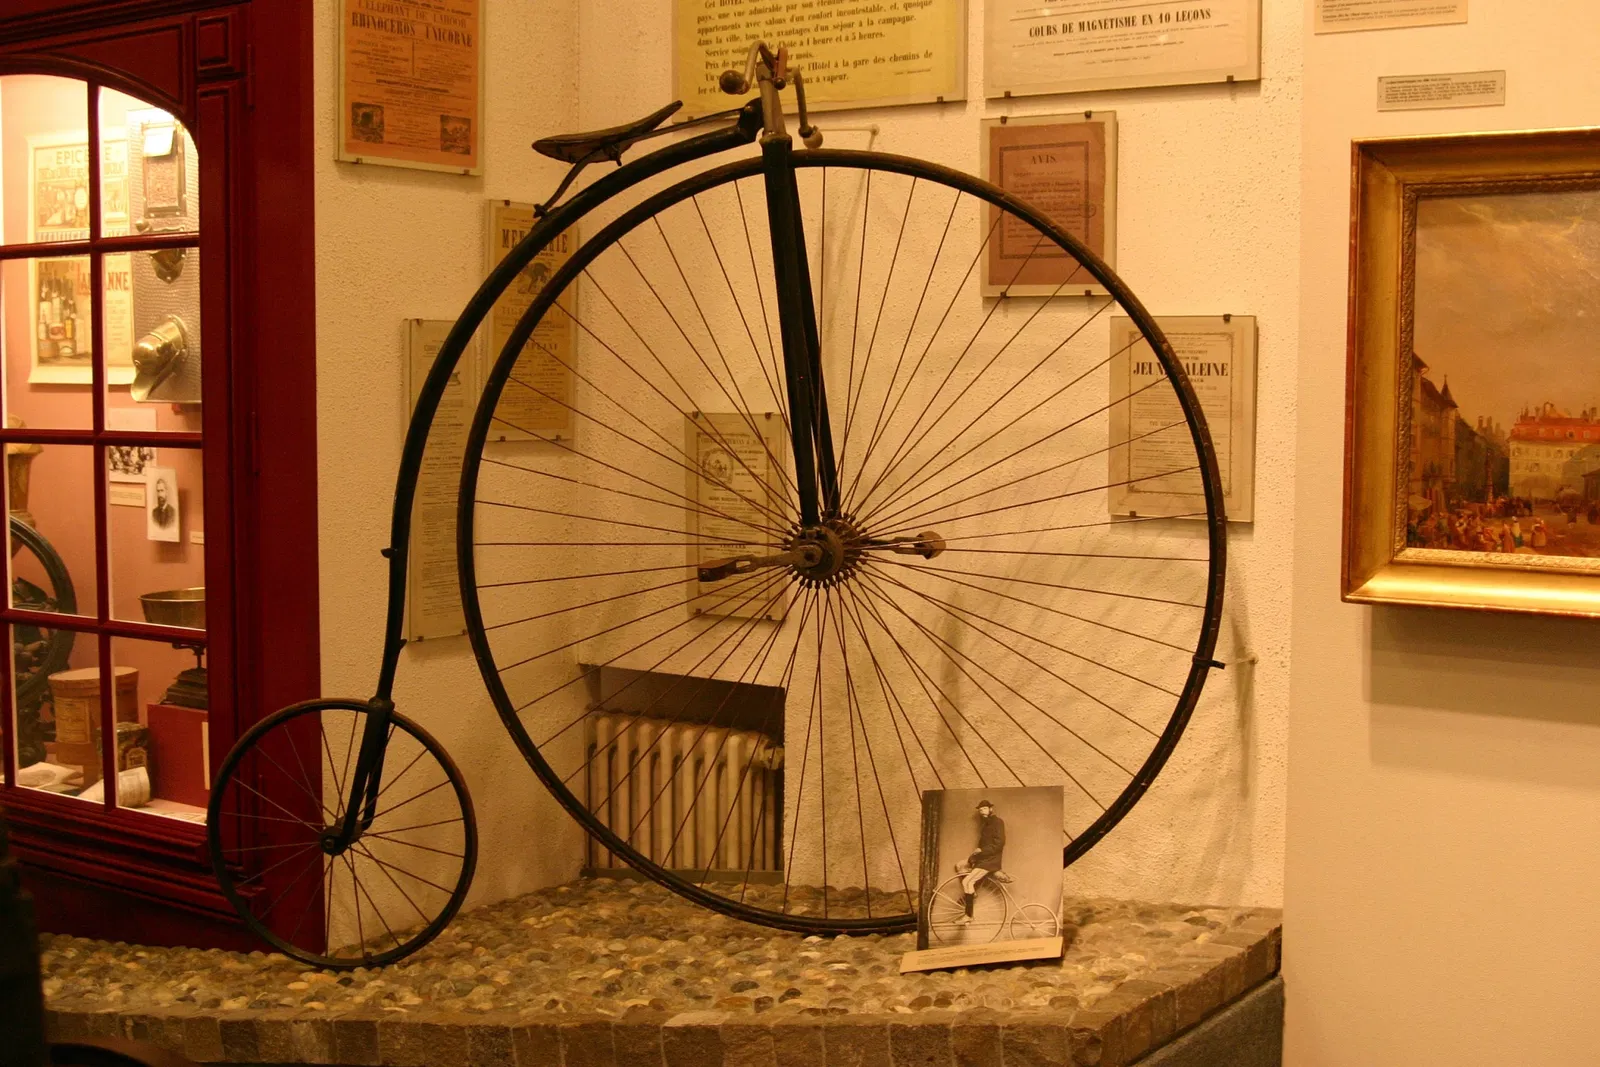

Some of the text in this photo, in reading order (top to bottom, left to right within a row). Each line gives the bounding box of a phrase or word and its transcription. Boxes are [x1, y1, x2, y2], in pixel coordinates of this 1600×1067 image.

[749, 5, 782, 16] admirable
[786, 4, 797, 12] par
[352, 12, 416, 36] RHINOCEROS
[697, 22, 741, 35] appartements
[745, 20, 761, 28] avec
[765, 15, 786, 25] salons
[808, 10, 833, 21] confort
[697, 37, 713, 47] dans
[715, 36, 723, 44] la
[776, 27, 811, 38] avantages
[867, 17, 874, 26] la
[878, 13, 917, 26] campagne.
[1029, 23, 1058, 38] COURS
[1062, 21, 1074, 34] DE
[1142, 13, 1154, 26] EN
[1158, 11, 1171, 24] 10
[1176, 7, 1212, 25] LEÇONS
[812, 35, 833, 46] heure
[835, 34, 842, 43] et
[858, 30, 886, 42] heures.
[705, 47, 729, 57] Service
[842, 58, 850, 68] la
[853, 57, 870, 70] gare
[873, 55, 886, 64] des
[889, 51, 920, 62] chemins
[924, 49, 933, 59] de
[705, 59, 720, 70] Prix
[722, 59, 730, 67] de
